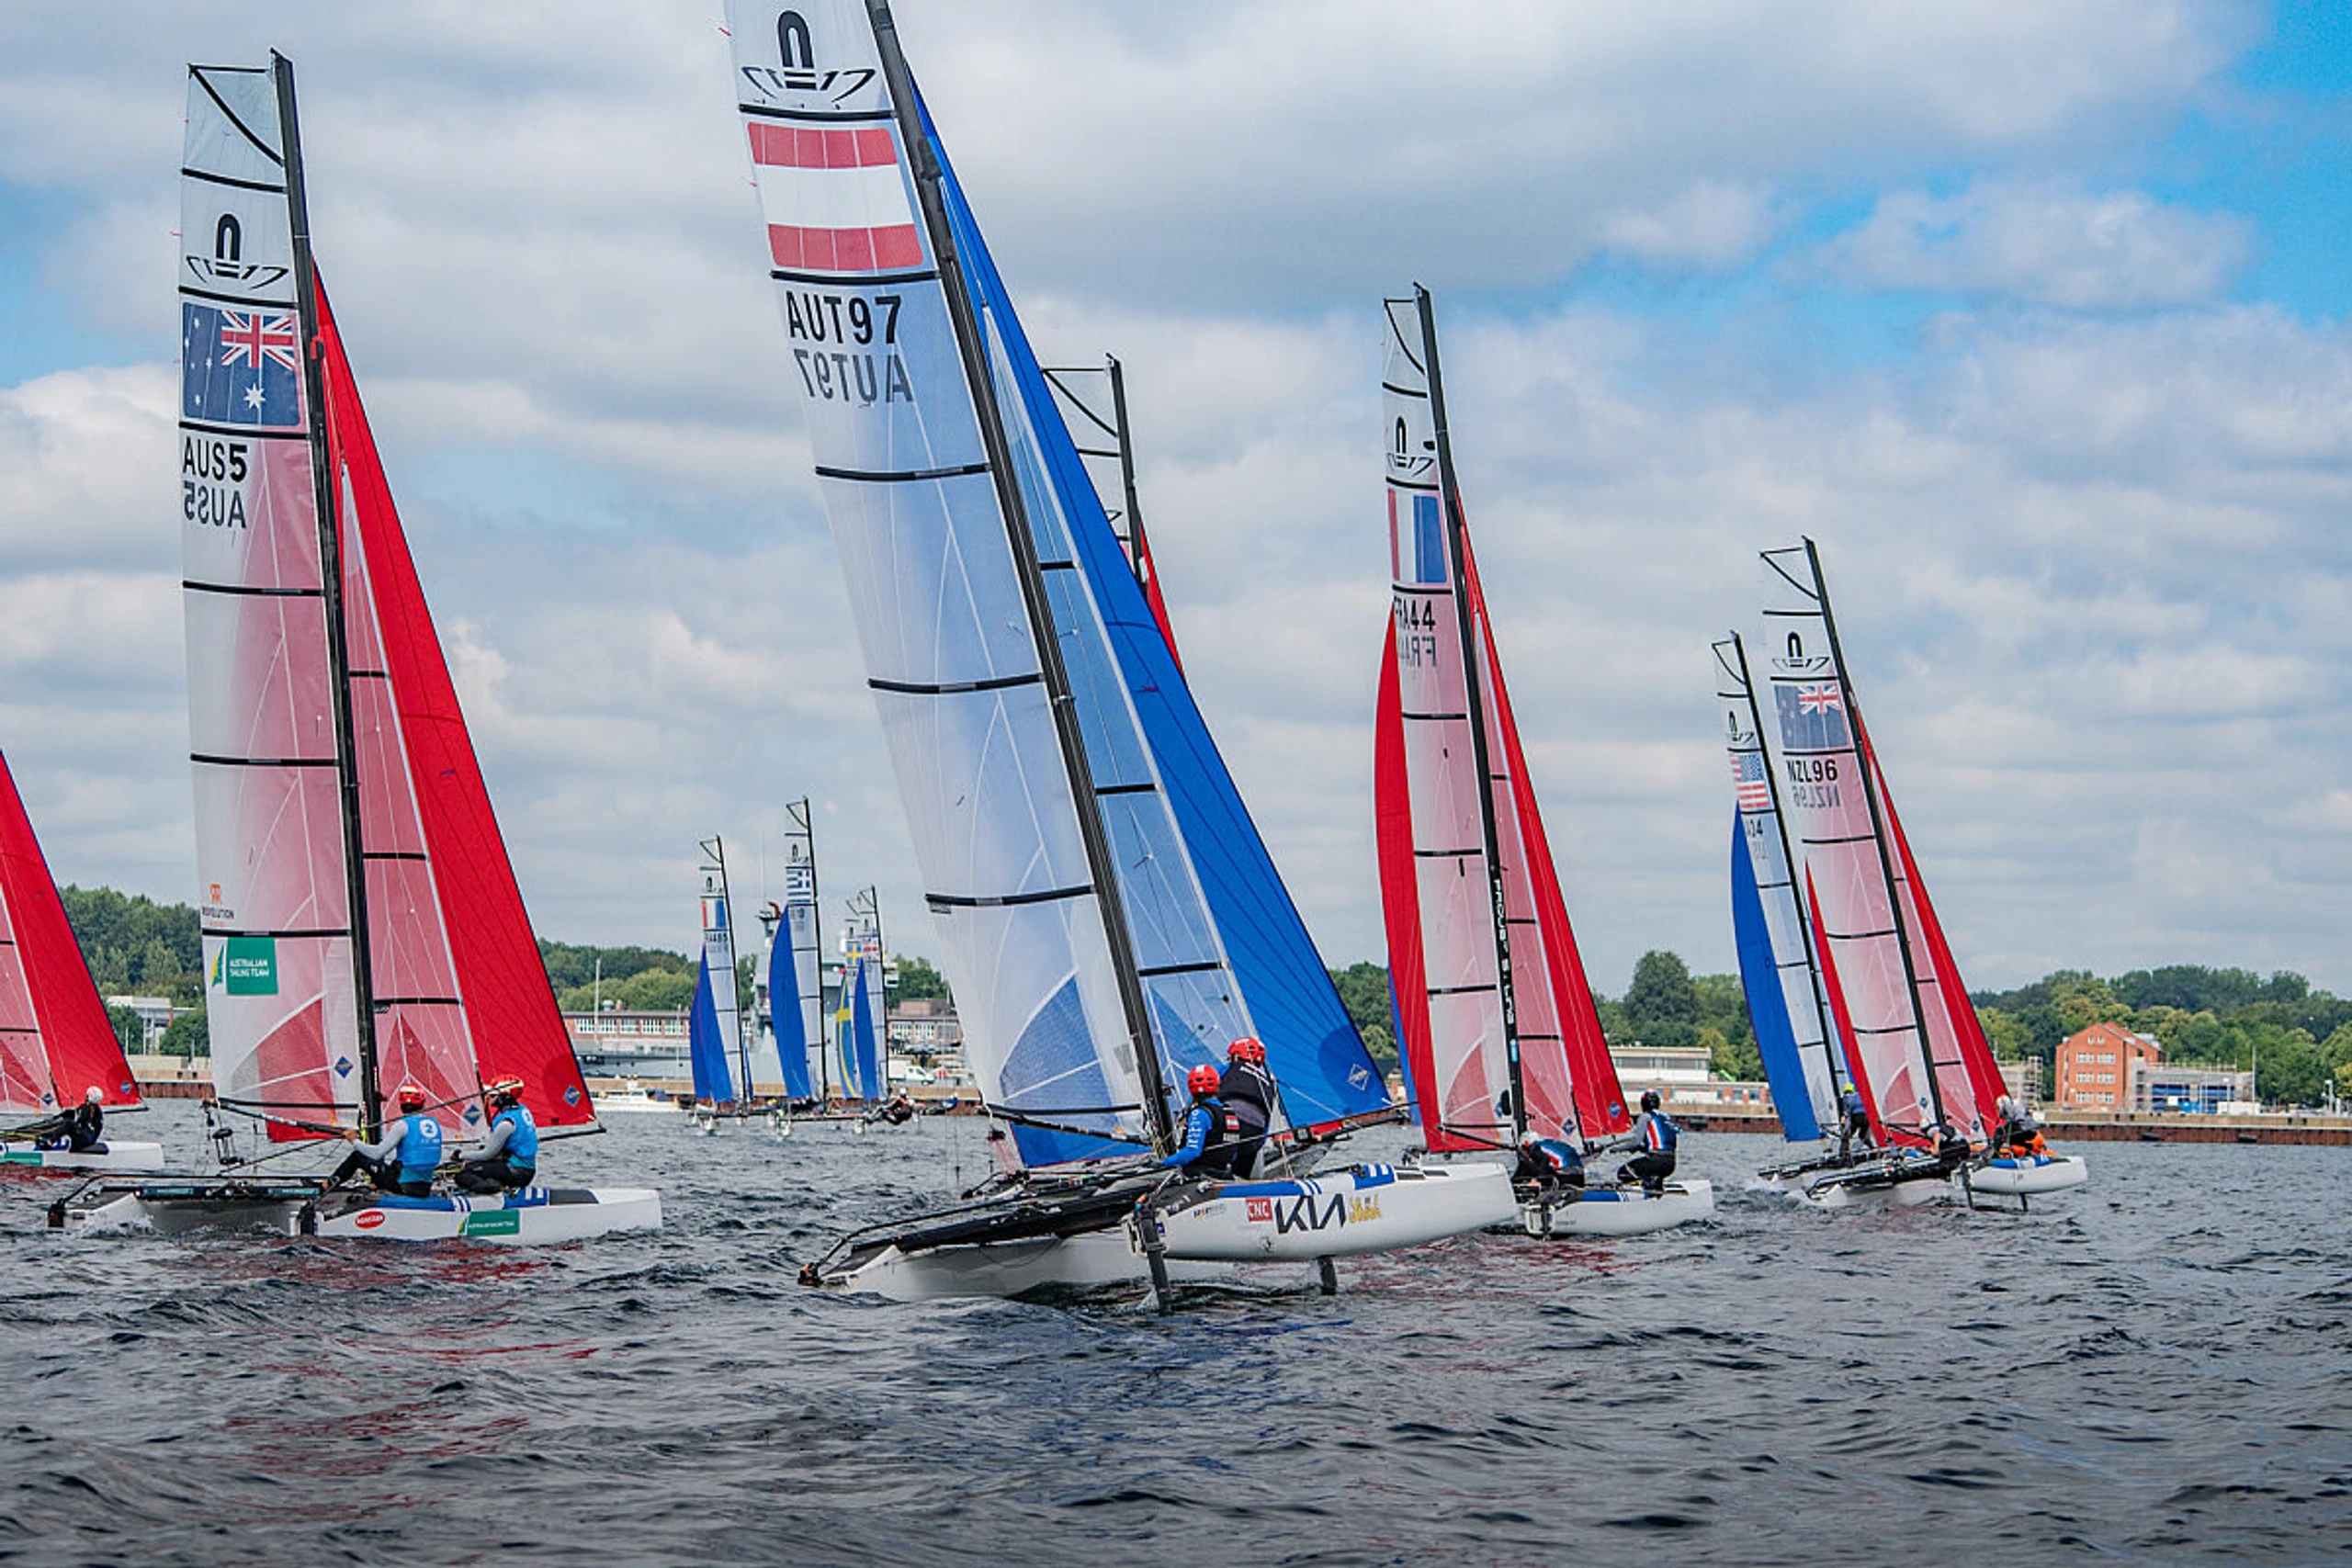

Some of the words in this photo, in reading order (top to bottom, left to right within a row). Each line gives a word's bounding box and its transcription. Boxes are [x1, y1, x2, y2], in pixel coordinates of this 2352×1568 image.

[786, 291, 901, 344] AUT97
[182, 436, 248, 483] AUS5
[1785, 759, 1838, 782] NZL96
